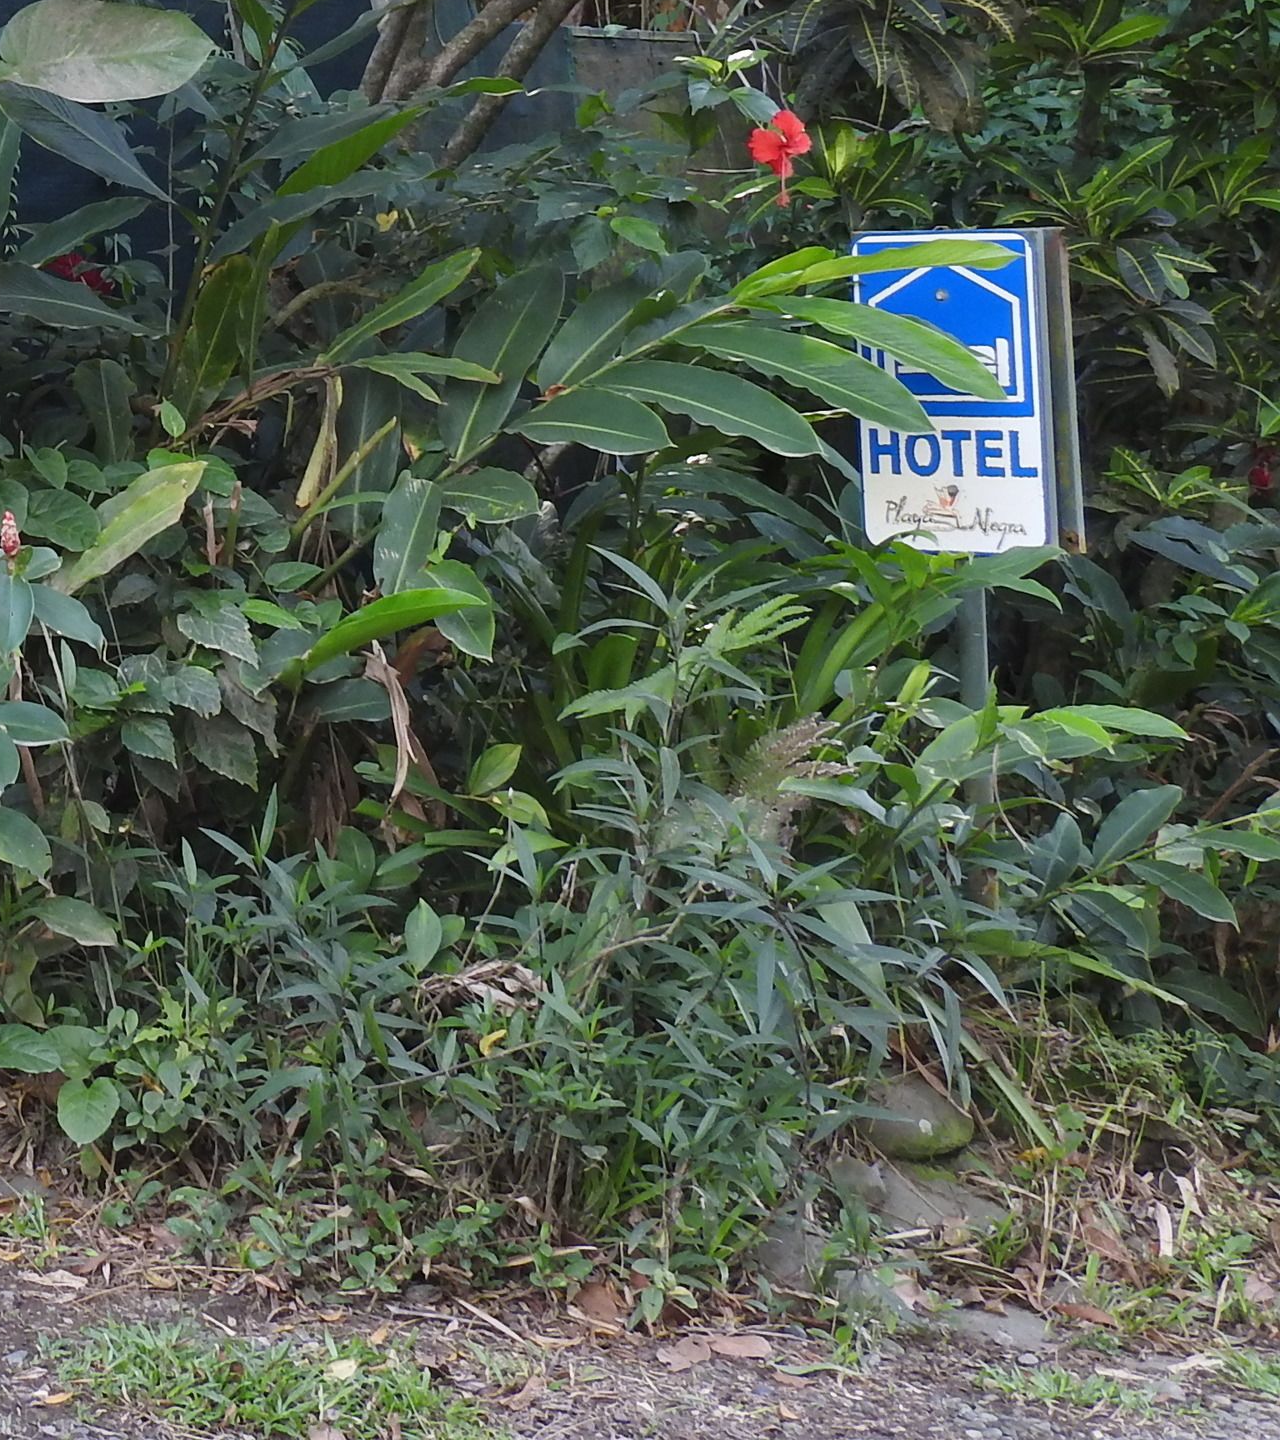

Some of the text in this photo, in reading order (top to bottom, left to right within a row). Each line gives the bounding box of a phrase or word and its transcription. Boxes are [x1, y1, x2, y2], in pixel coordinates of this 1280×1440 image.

[869, 428, 1039, 478] HOTEL
[885, 495, 1028, 550] Playa Negra
